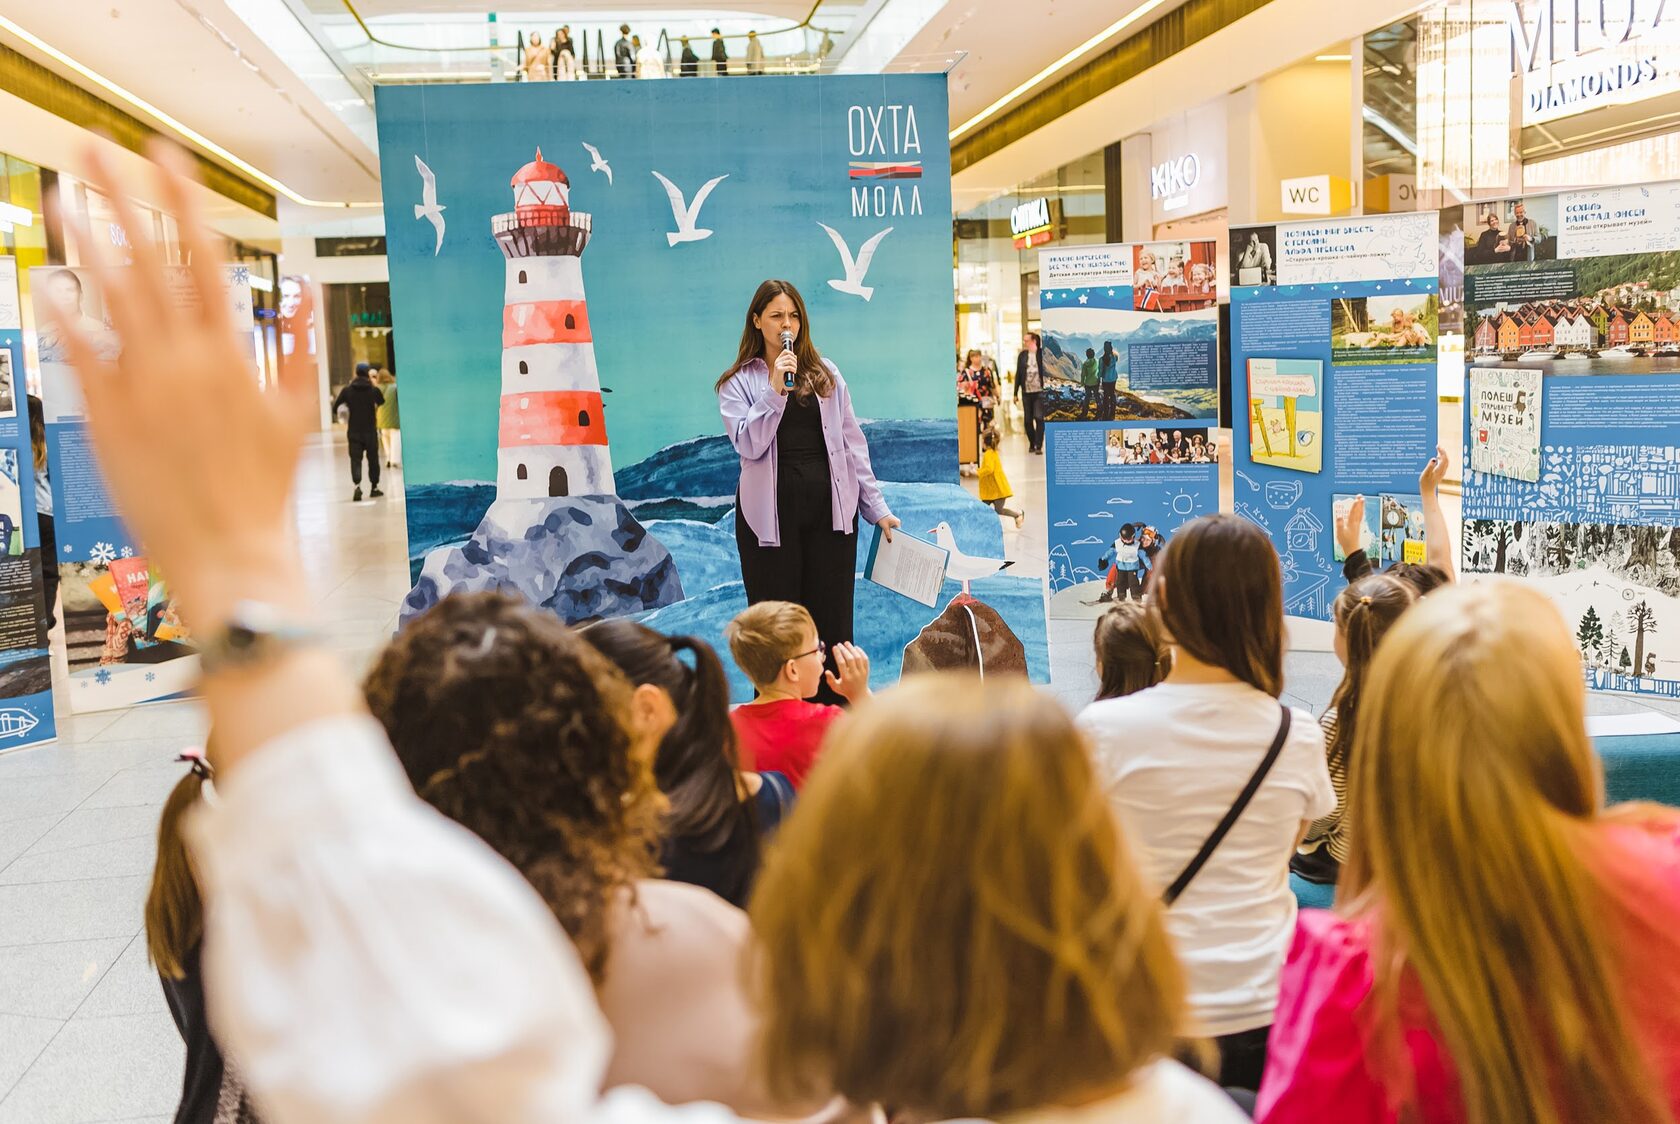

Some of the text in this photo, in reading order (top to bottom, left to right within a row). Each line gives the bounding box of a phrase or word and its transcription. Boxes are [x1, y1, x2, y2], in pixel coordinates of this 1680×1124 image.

[1527, 57, 1658, 113] DIAMONDS
[848, 105, 921, 156] ОХТА
[1151, 153, 1200, 200] KIKO
[851, 185, 923, 217] МОЛЛ
[1289, 187, 1320, 203] WC
[1566, 203, 1601, 213] ОСХИЛЬ
[1566, 208, 1646, 223] КАНСТАД ЮНСЕН
[1010, 197, 1050, 235] ОПТИКА
[1344, 226, 1374, 235] ВМЕСТЕ
[1593, 221, 1627, 230] открывает
[1481, 391, 1514, 403] ПОЛЕШ
[1481, 403, 1512, 412] ОТКРЫВАЕТ
